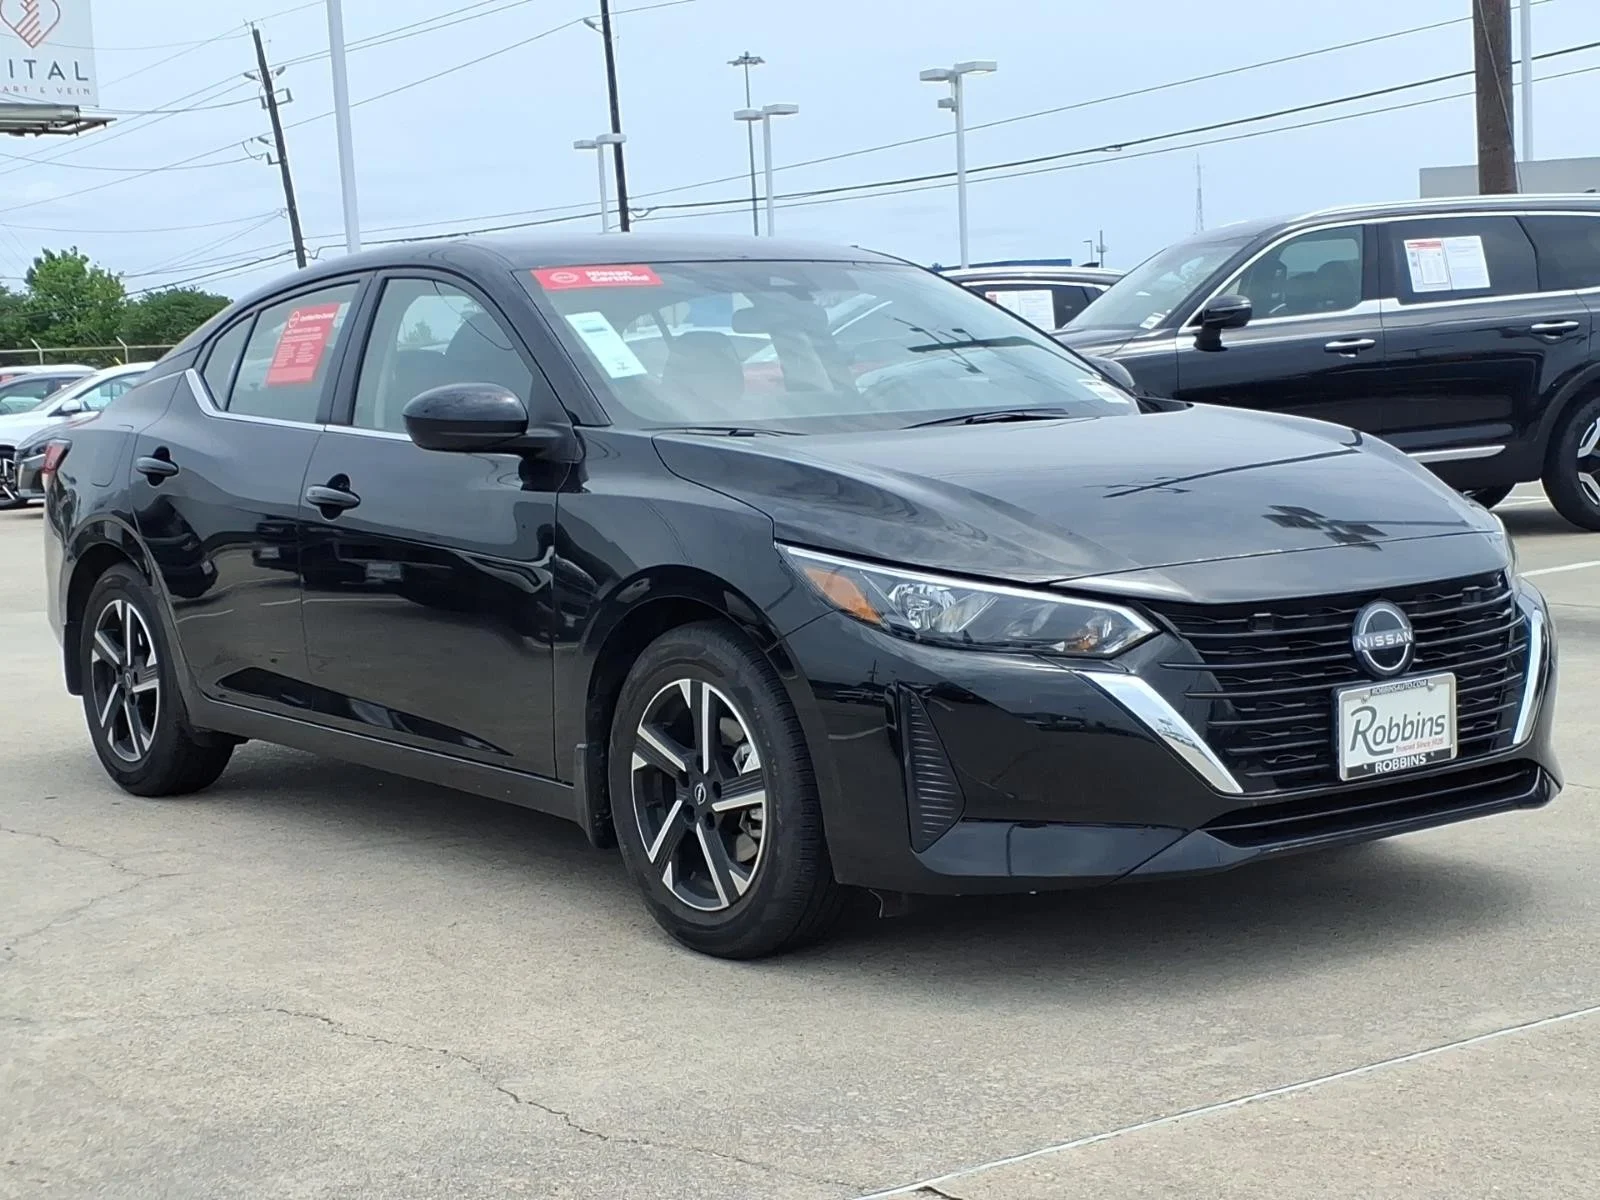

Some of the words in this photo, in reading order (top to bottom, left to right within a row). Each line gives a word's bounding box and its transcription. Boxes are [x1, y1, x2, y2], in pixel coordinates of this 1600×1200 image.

[8, 58, 89, 81] ITAL
[56, 87, 91, 95] VEIN
[1357, 631, 1413, 649] NISSAN
[1350, 705, 1446, 757] Robbins
[1375, 753, 1427, 773] ROBBINS
